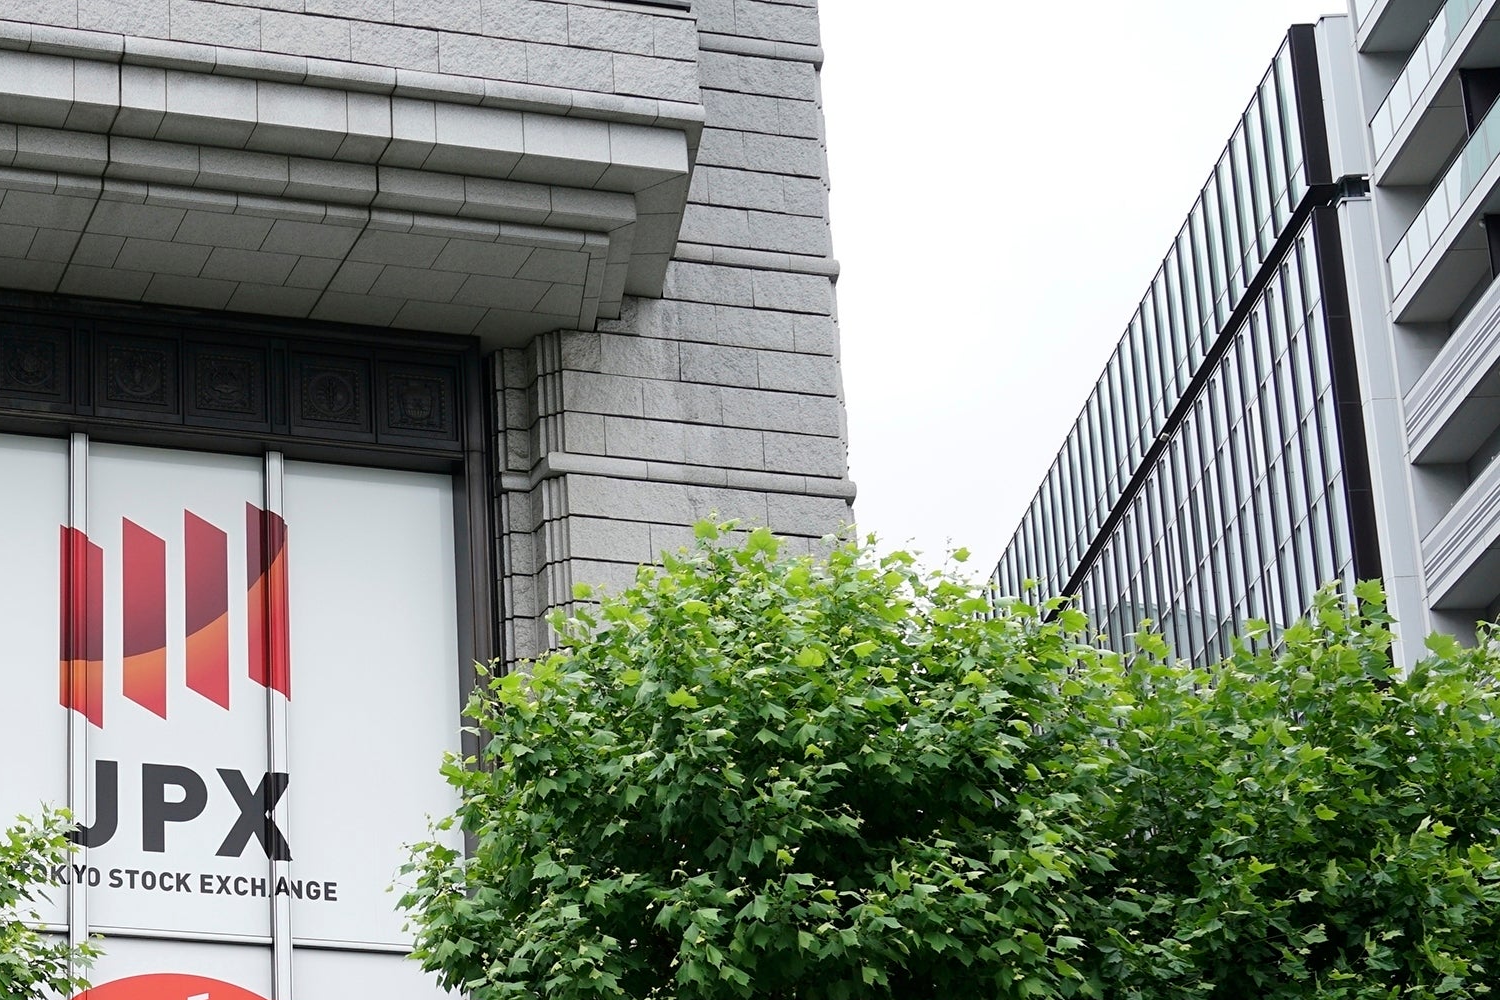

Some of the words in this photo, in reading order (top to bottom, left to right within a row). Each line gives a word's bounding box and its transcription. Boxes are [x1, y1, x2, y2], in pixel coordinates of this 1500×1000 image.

[63, 759, 293, 862] JPX
[108, 868, 193, 893] STOCK
[200, 873, 338, 902] EXCHANGE
